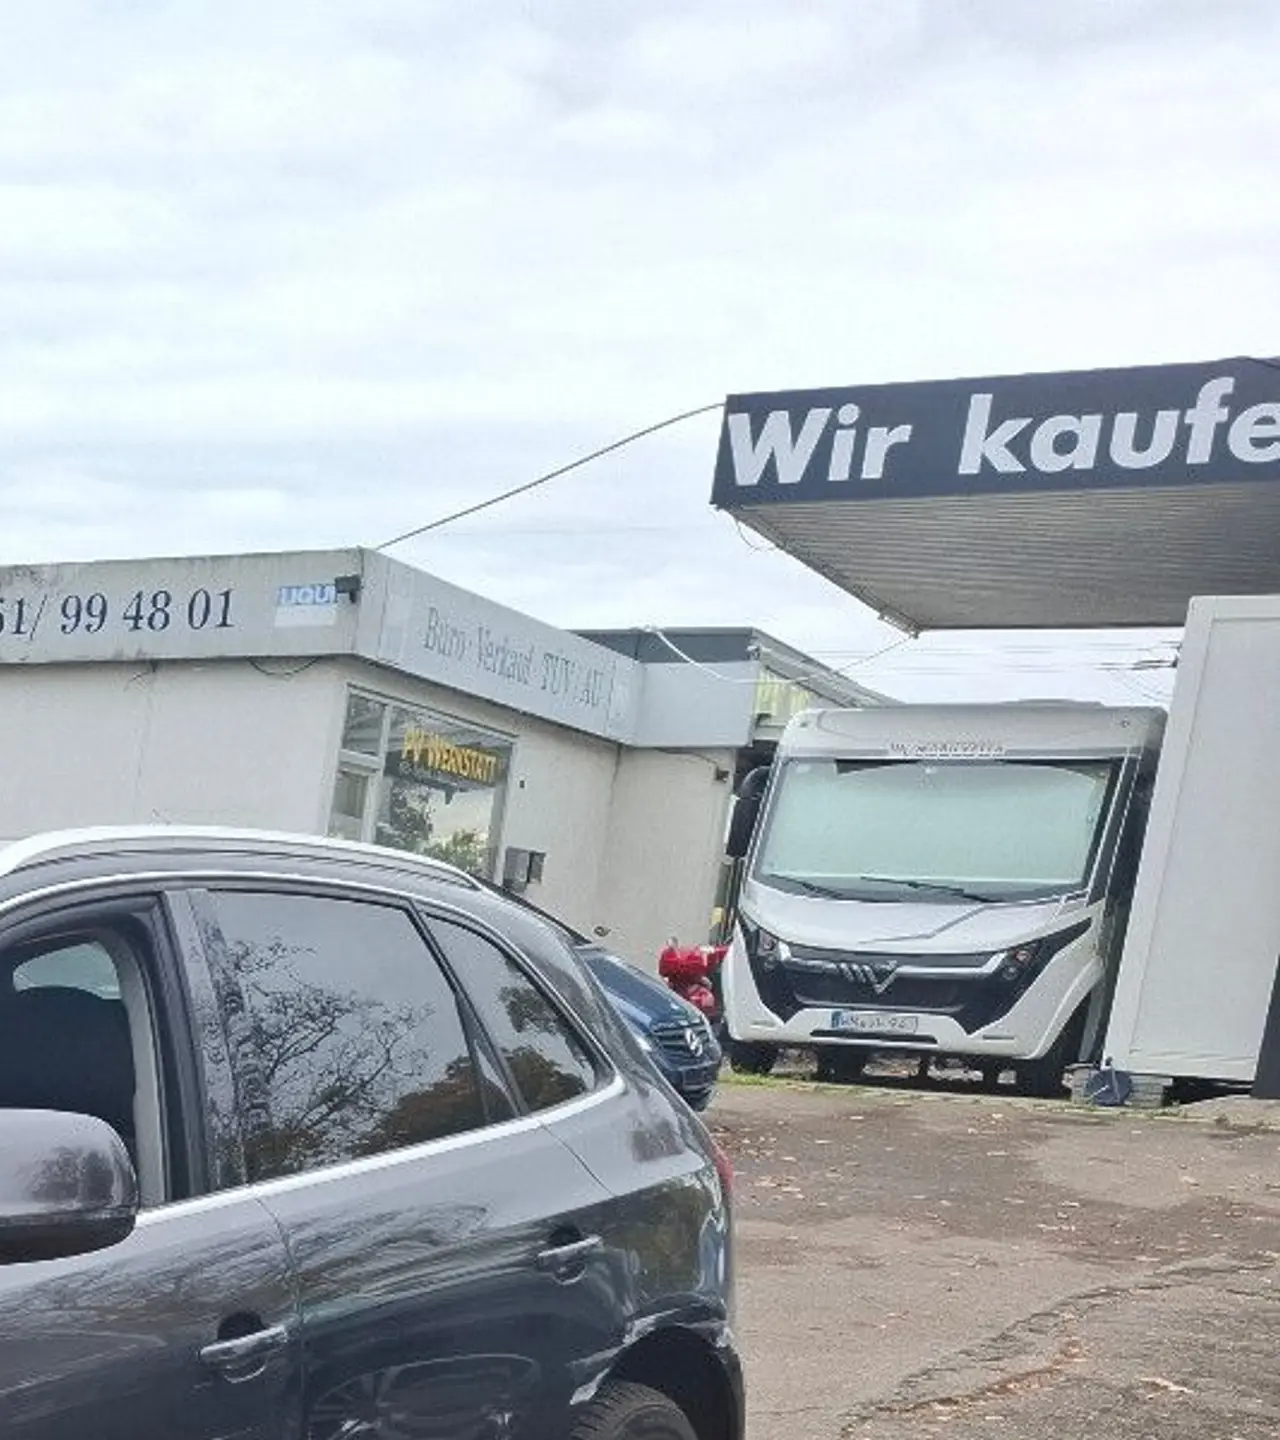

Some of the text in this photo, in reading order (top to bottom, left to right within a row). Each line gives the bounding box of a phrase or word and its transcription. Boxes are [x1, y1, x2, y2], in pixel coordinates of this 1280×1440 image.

[728, 377, 1280, 487] Wir kaufe
[60, 592, 108, 635] 99
[122, 590, 173, 632] 48
[187, 588, 236, 630] 01
